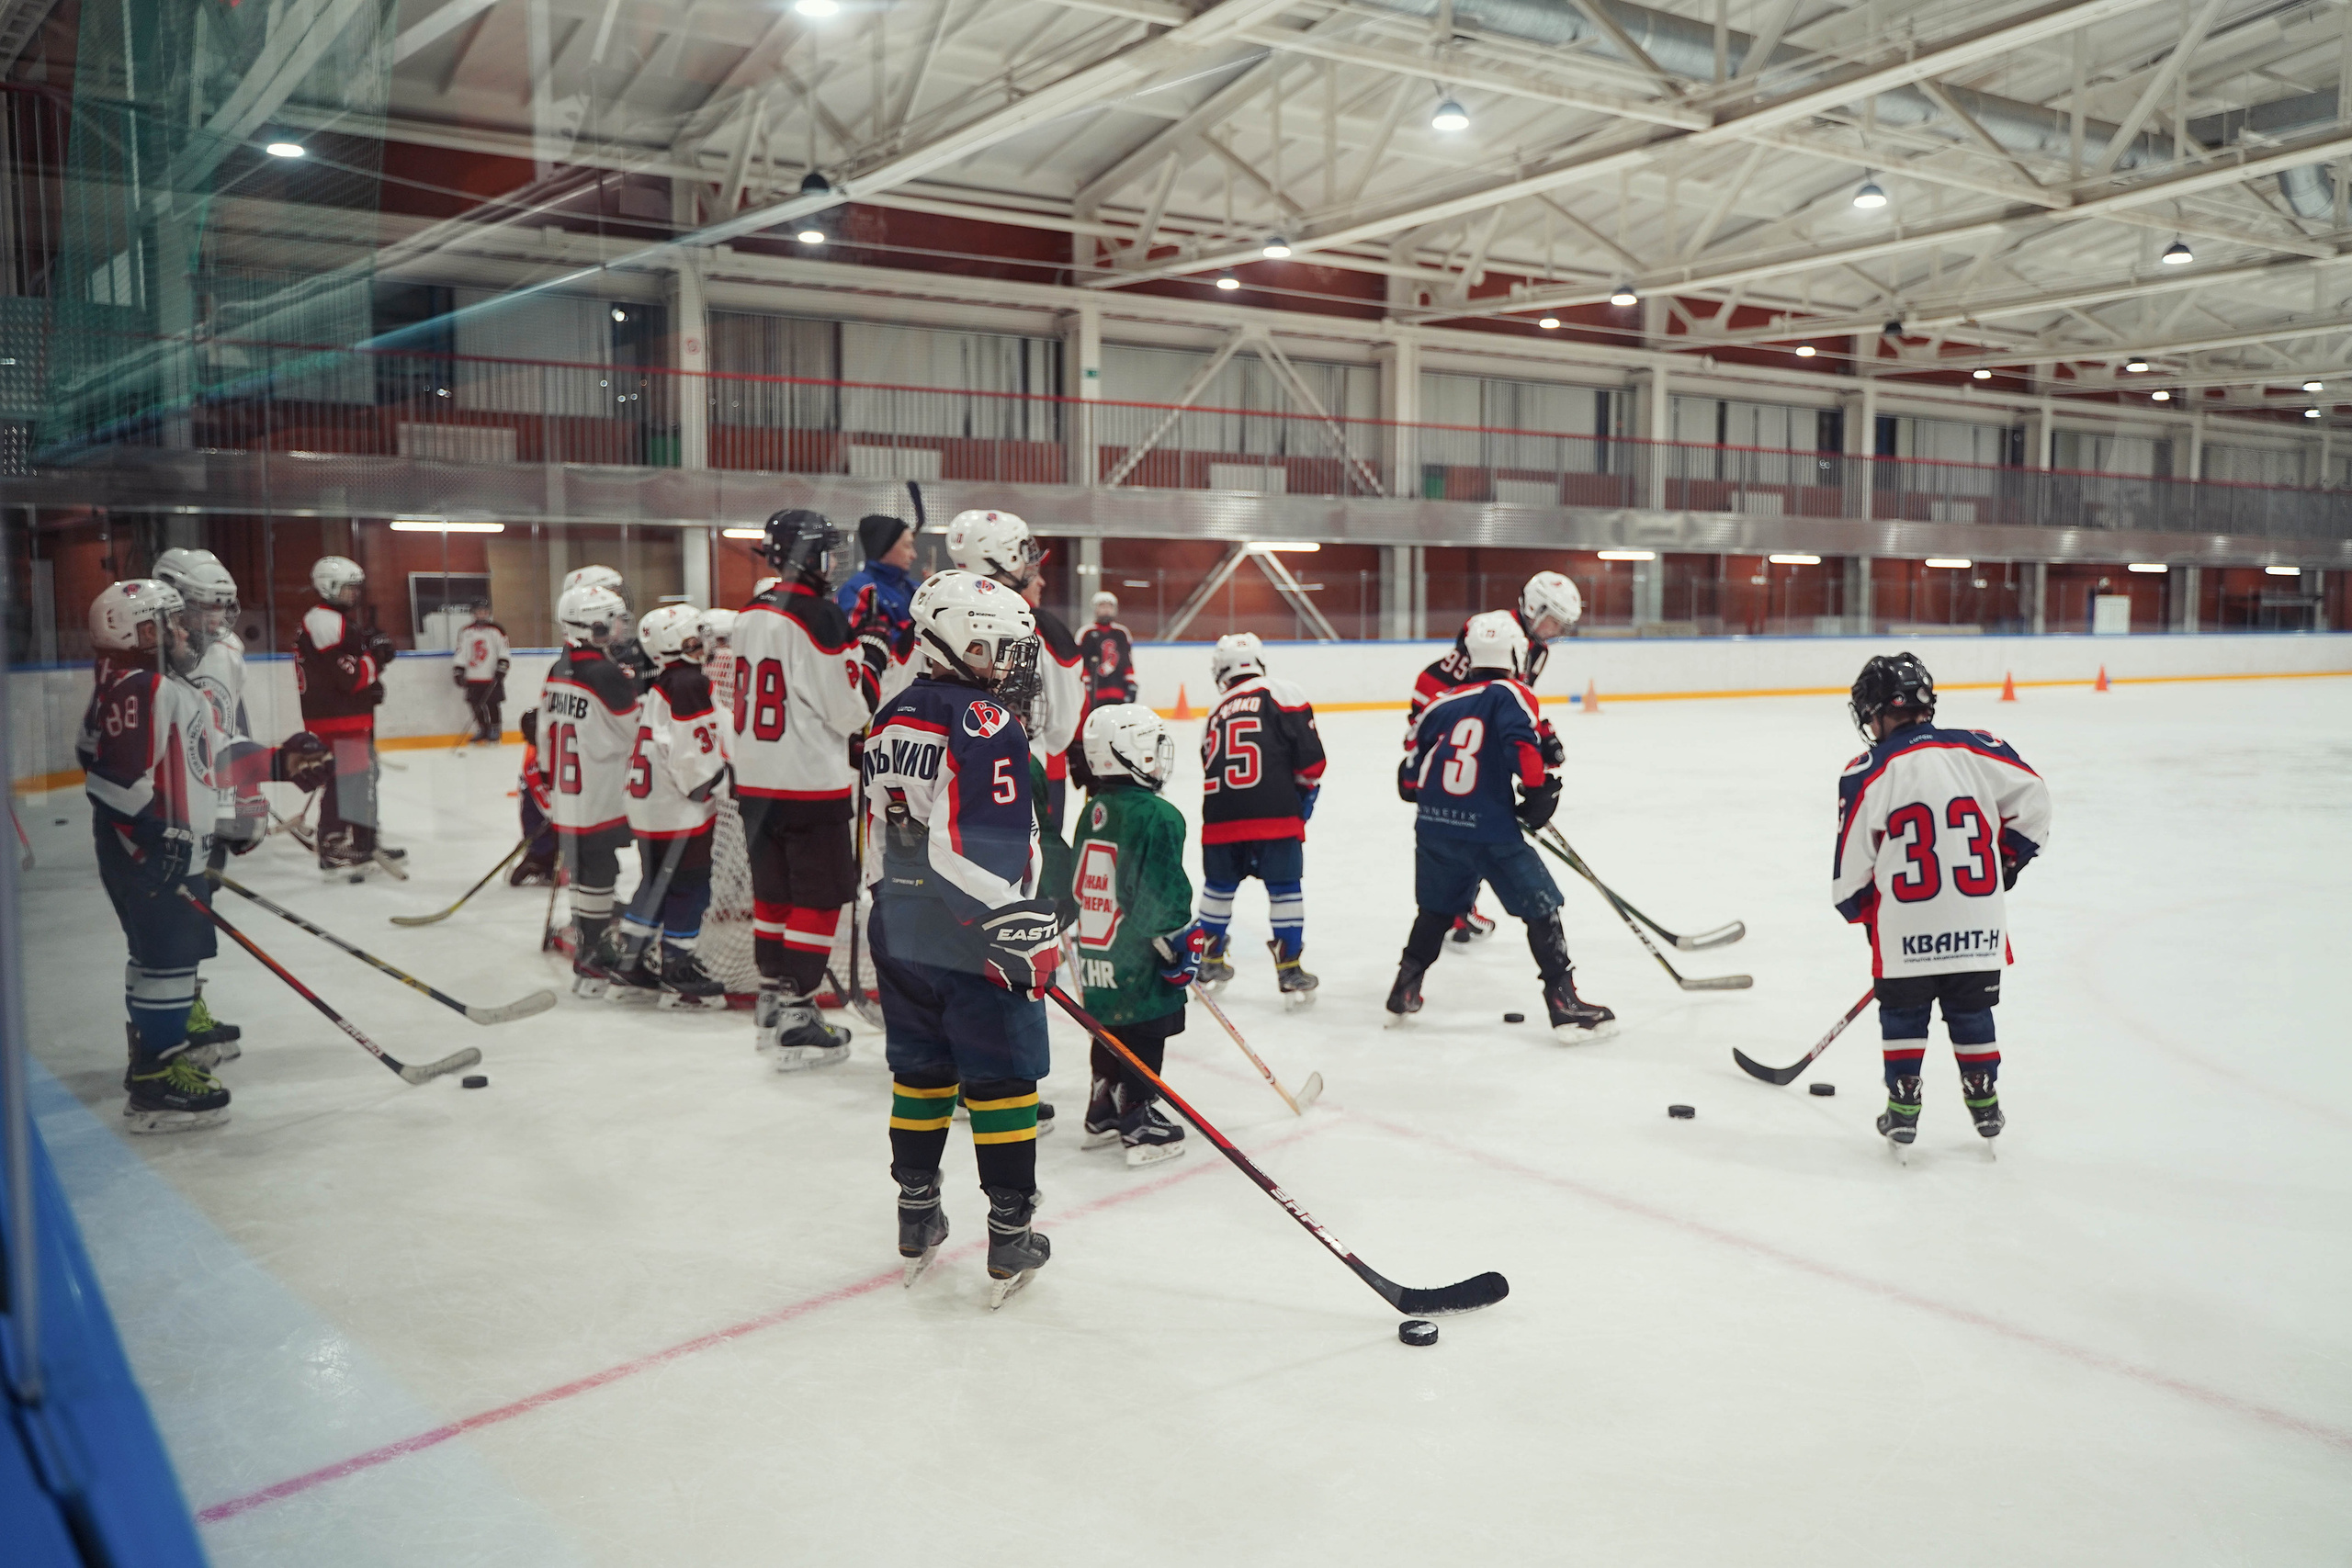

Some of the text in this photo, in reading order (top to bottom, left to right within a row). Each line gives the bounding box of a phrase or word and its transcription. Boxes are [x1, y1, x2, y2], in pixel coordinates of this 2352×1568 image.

[992, 757, 1017, 805] 5
[1887, 795, 1997, 904] 33
[996, 918, 1058, 942] EAST
